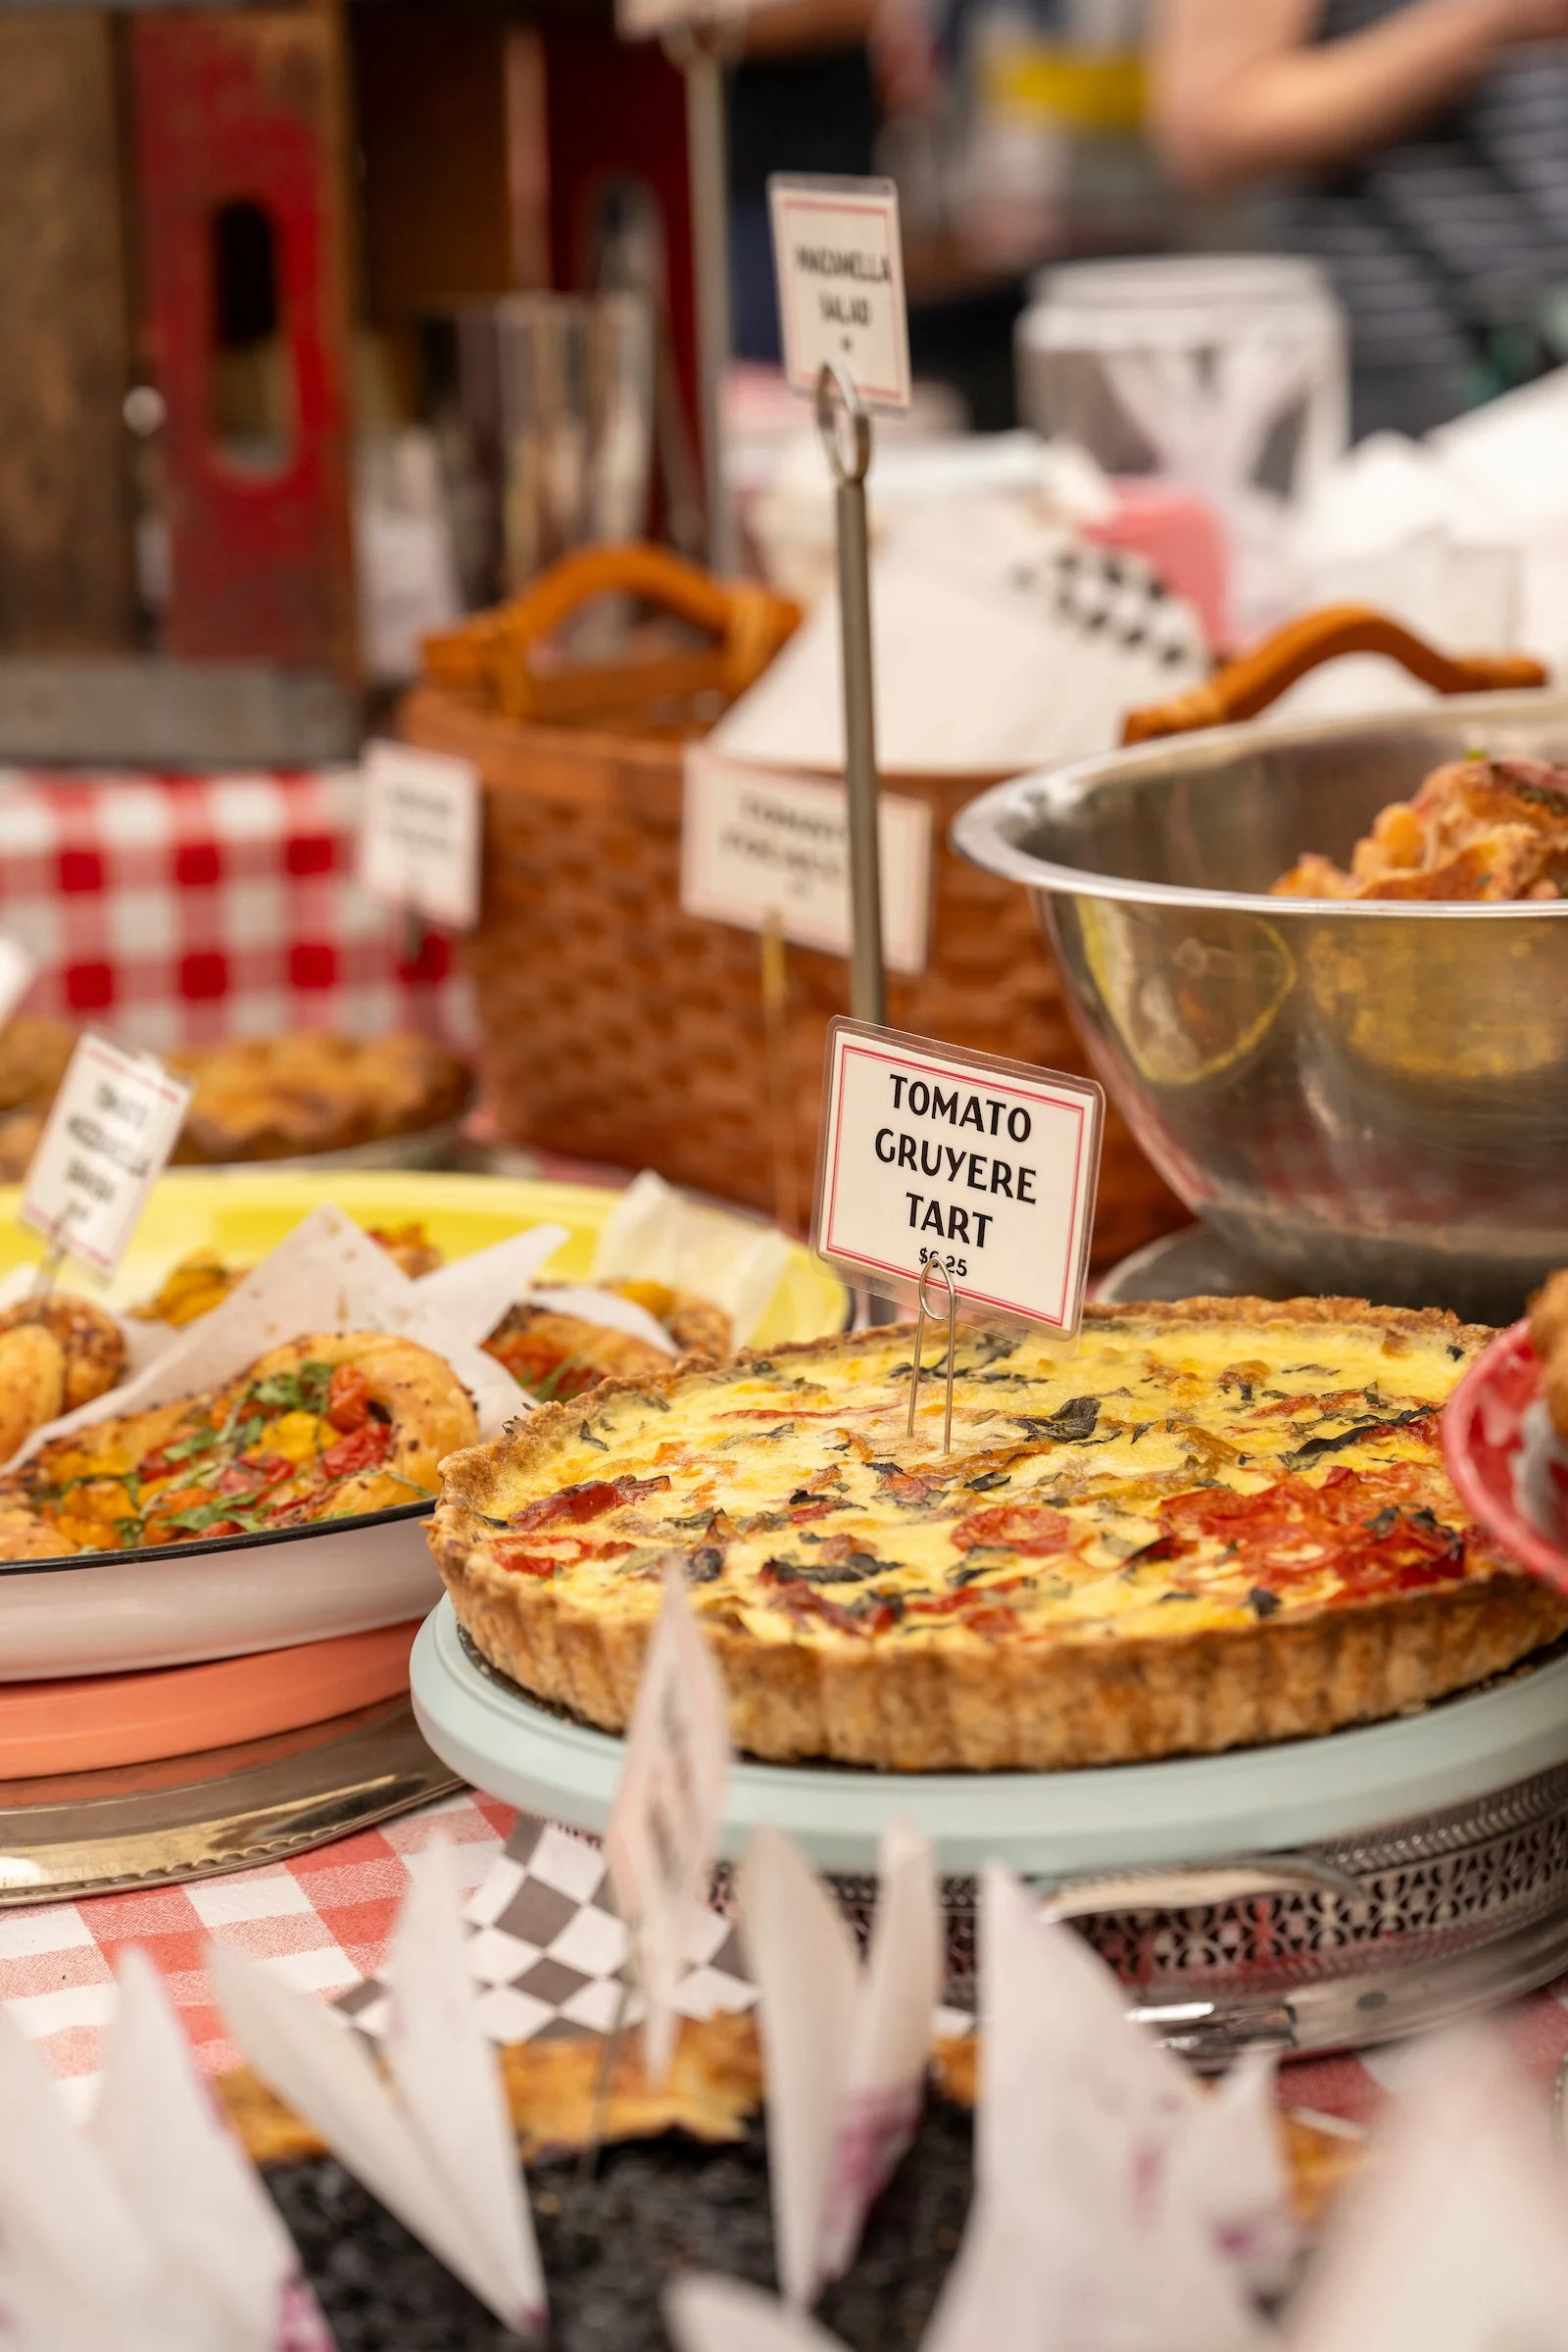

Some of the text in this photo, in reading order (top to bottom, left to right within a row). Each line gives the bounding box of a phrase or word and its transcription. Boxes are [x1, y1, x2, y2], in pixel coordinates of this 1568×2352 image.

[890, 1074, 1031, 1142] TOMATO
[875, 1128, 1036, 1204] GRUYERE
[906, 1193, 993, 1248] TART
[919, 1248, 967, 1276] $625
